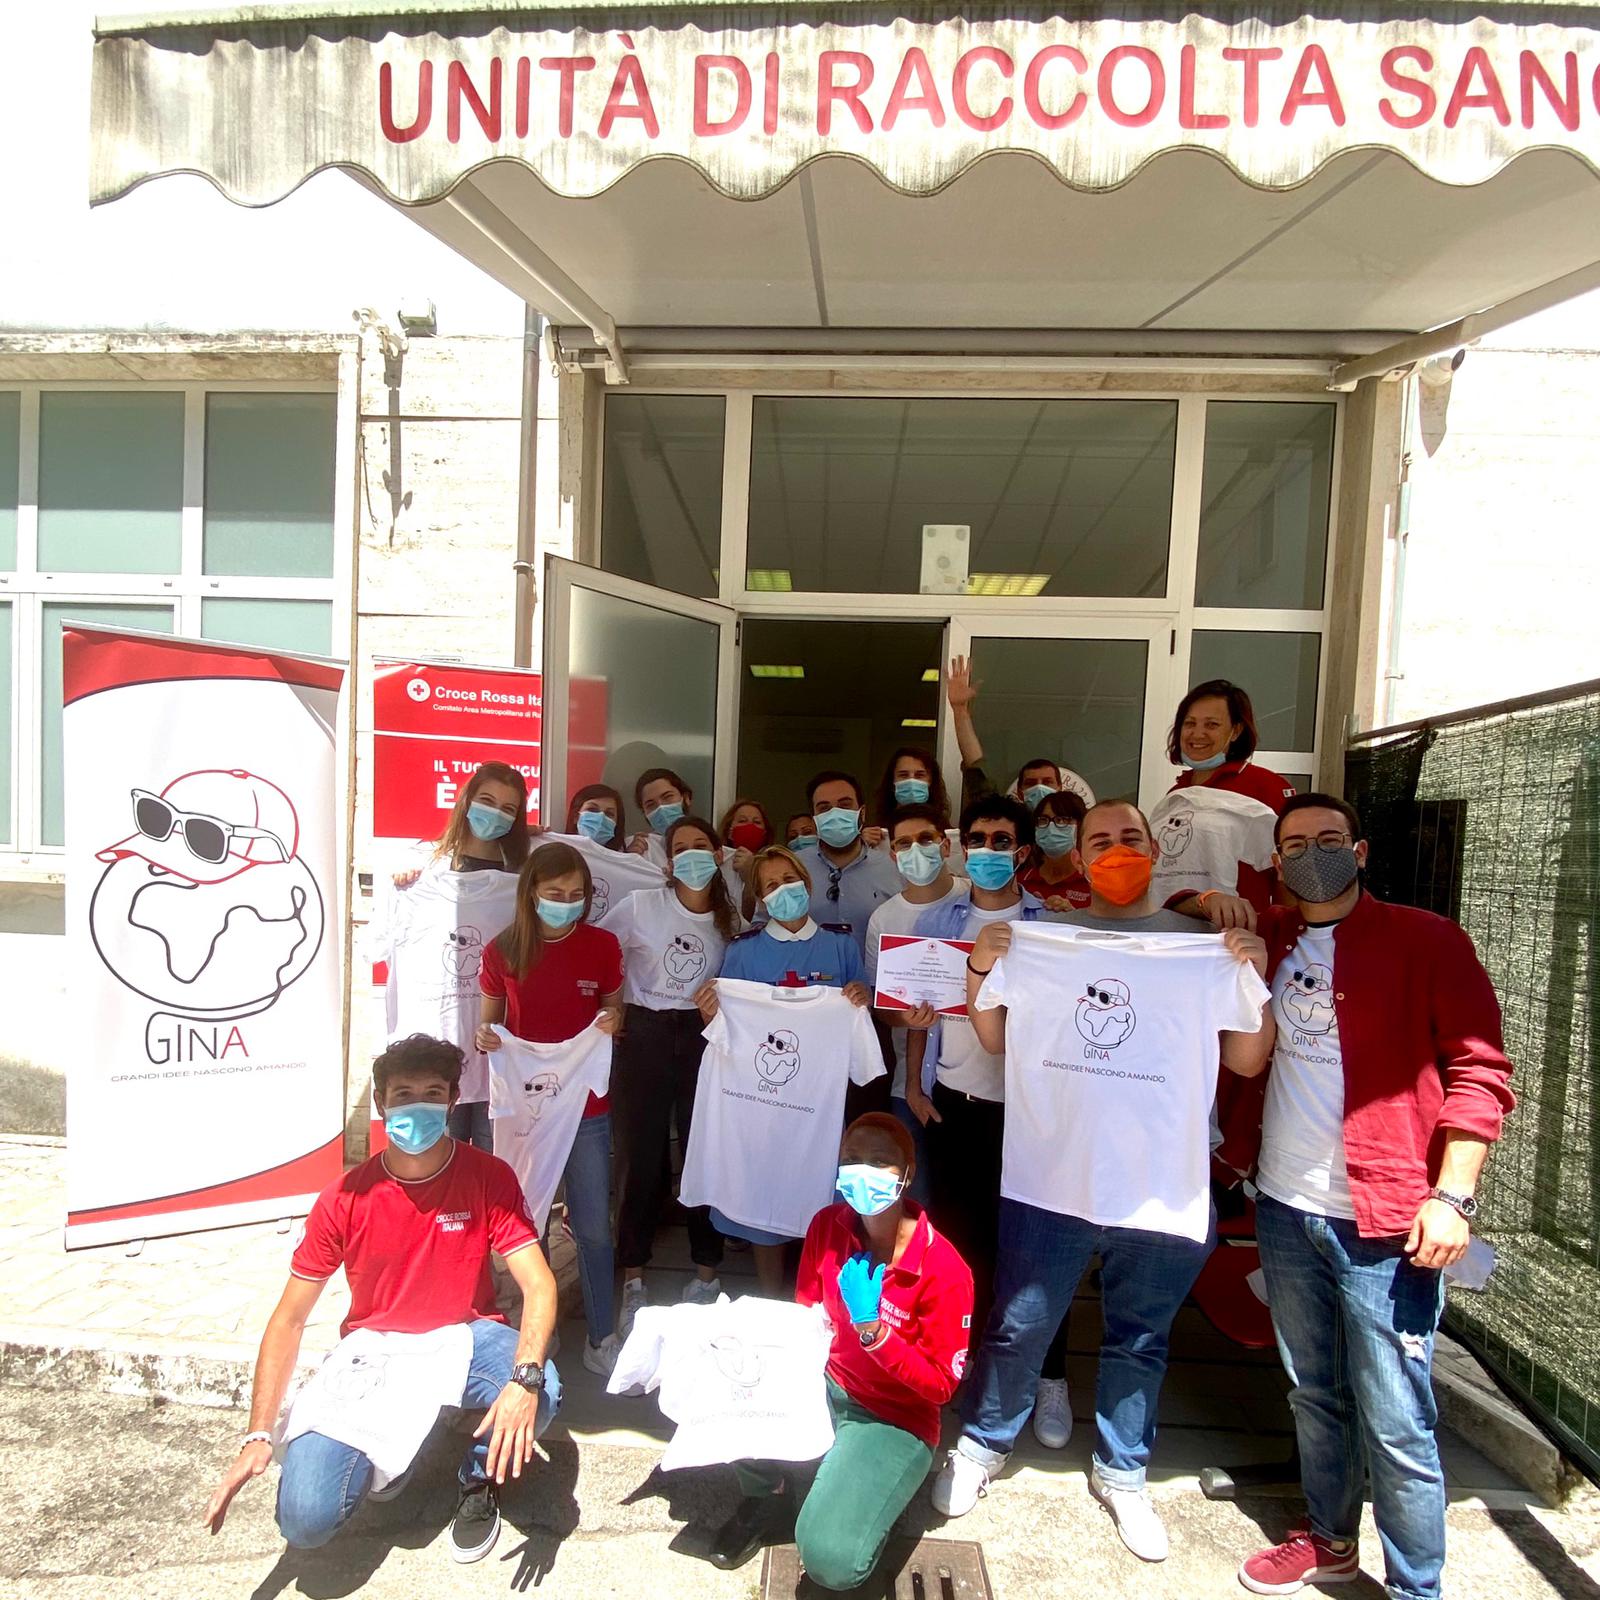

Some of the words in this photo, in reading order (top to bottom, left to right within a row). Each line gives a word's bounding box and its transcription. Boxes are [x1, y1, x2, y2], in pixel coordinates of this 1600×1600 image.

[379, 33, 661, 144] UNITÀ
[693, 50, 779, 137] DI
[816, 43, 1346, 137] RACCOLTA
[1378, 45, 1600, 132] SAN
[435, 686, 477, 701] Croce
[481, 690, 525, 705] Rossa
[432, 704, 463, 712] Comitato
[463, 706, 480, 714] Area
[480, 707, 524, 717] Metropolitana
[433, 760, 447, 773] IL
[436, 775, 457, 809] È
[145, 1011, 249, 1064] GINA
[1292, 1029, 1320, 1048] GINA
[1084, 1043, 1110, 1061] GINA
[110, 1073, 160, 1083] GRANDI
[162, 1070, 191, 1079] IDEE
[193, 1065, 253, 1076] NASCONO
[255, 1061, 307, 1072] AMANDO
[1042, 1059, 1068, 1072] GRANDI
[1068, 1063, 1084, 1073] IDEE
[1084, 1066, 1126, 1079] NASCONO
[1127, 1072, 1166, 1083] AMANDO
[758, 1079, 778, 1095] GINA
[757, 1097, 788, 1109] NASCONO
[787, 1103, 815, 1114] AMANDO
[436, 1214, 454, 1223] CROCE
